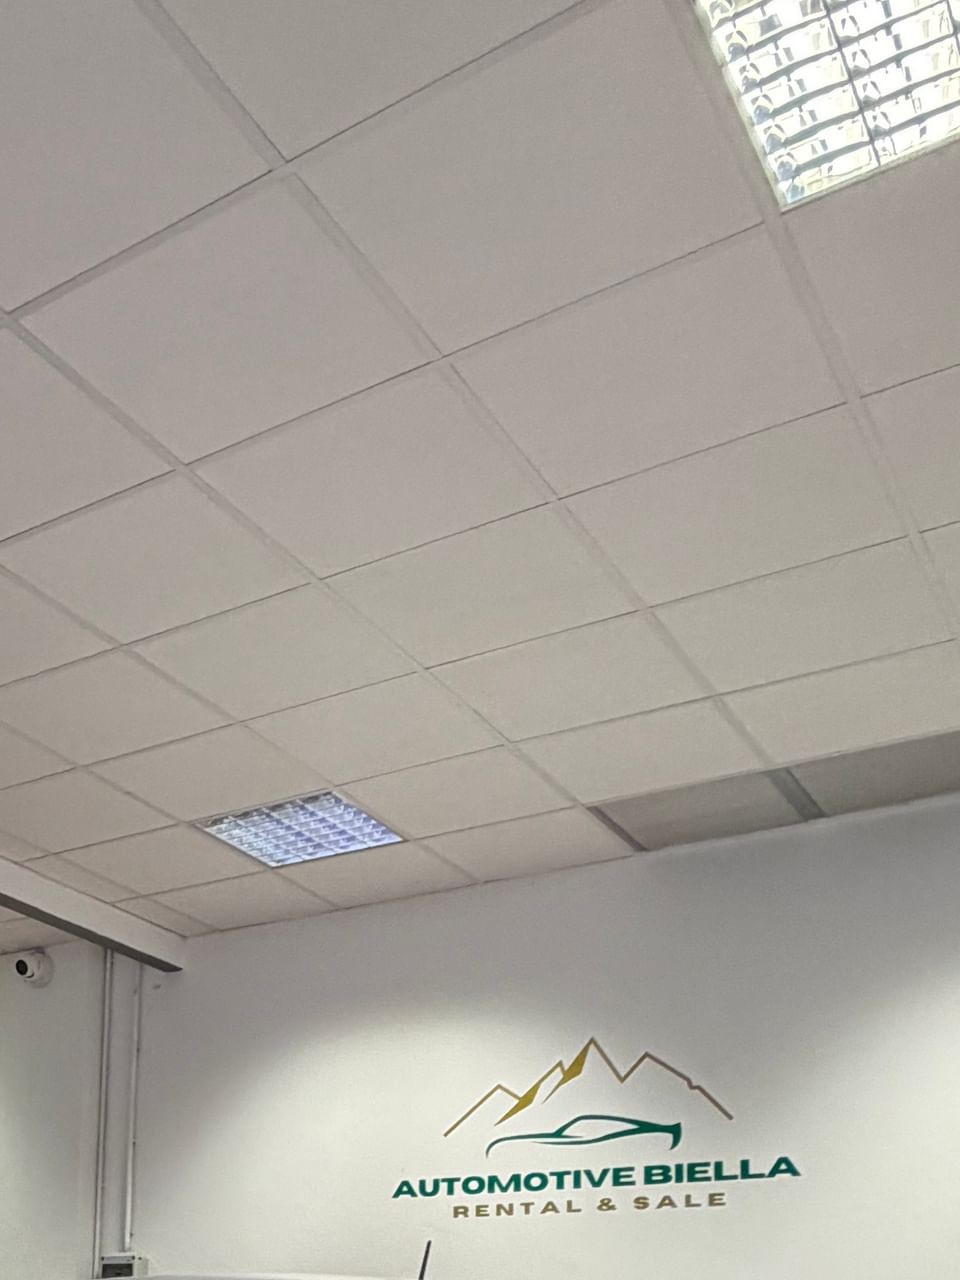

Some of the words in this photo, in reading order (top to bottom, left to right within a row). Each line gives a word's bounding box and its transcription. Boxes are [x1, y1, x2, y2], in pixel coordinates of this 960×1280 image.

[392, 1167, 635, 1198] AUTOMOTIVE
[643, 1156, 801, 1185] BIELLA
[452, 1200, 582, 1218] RENTAL
[597, 1198, 617, 1212] &
[633, 1193, 726, 1209] SALE
